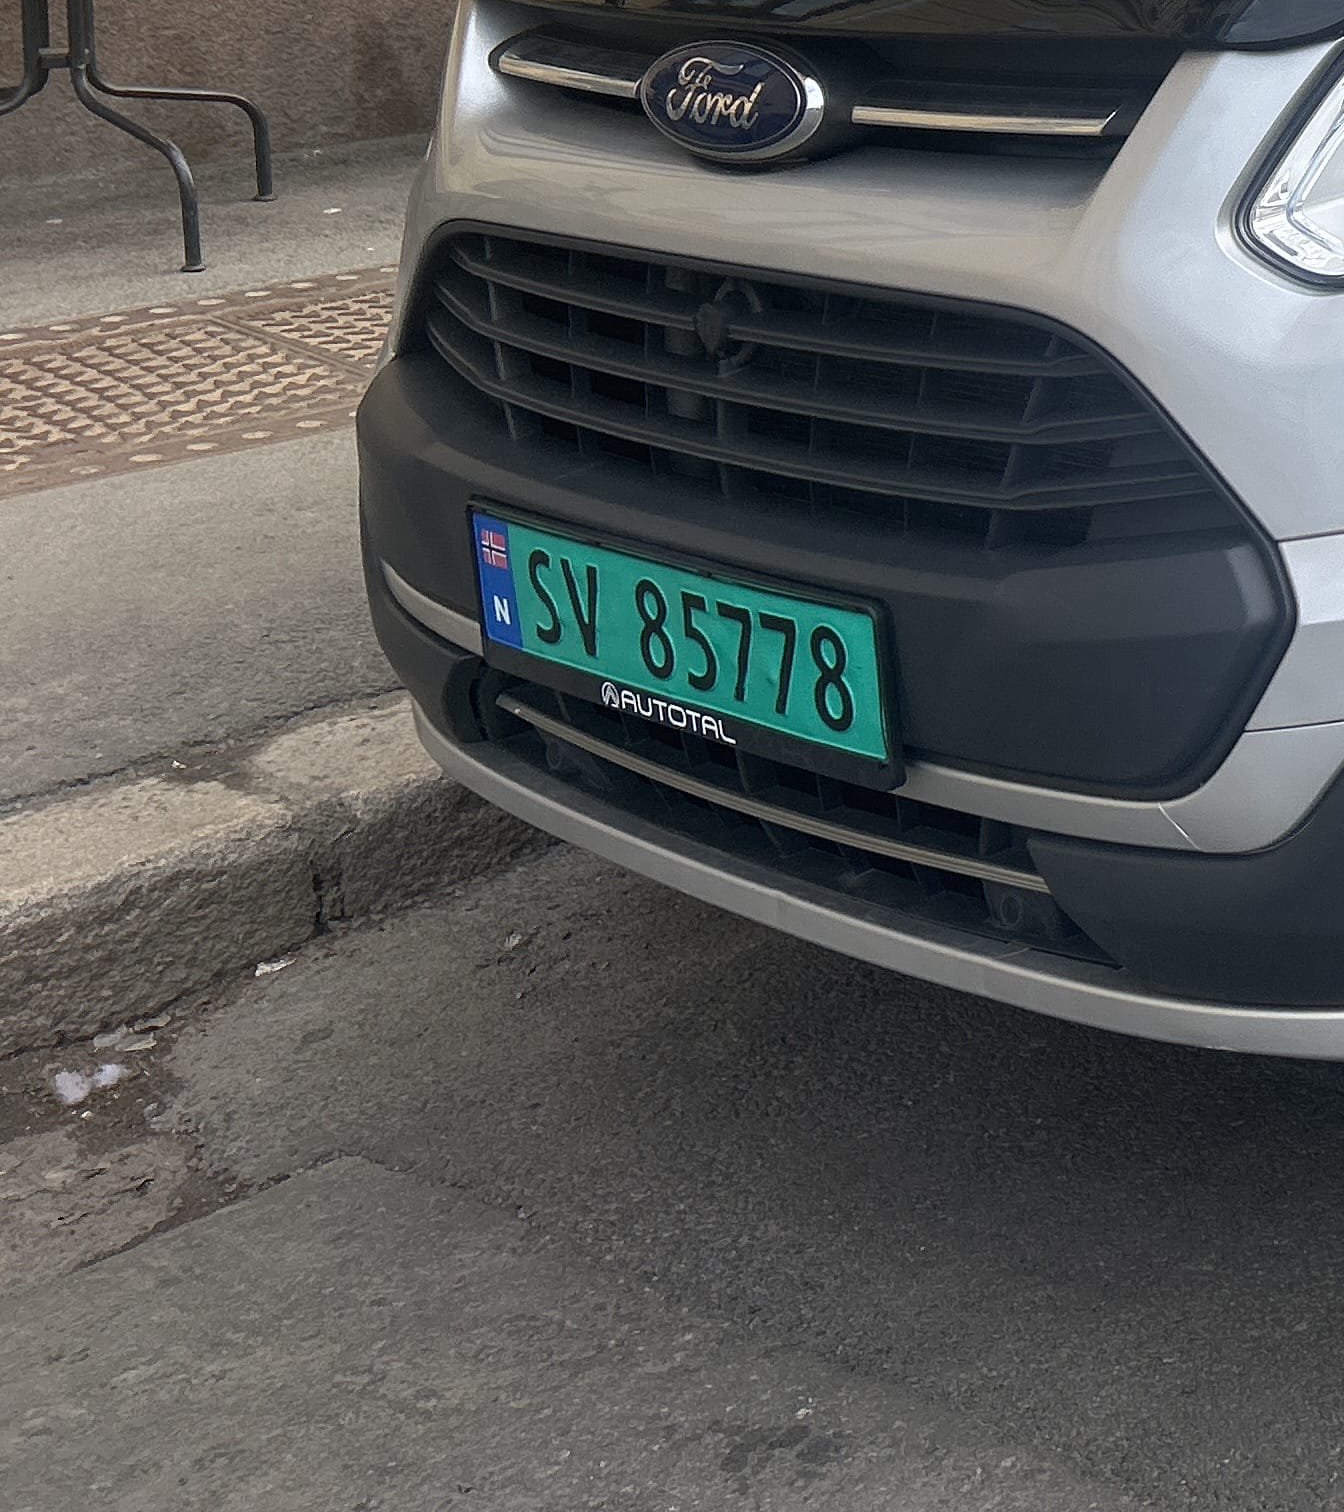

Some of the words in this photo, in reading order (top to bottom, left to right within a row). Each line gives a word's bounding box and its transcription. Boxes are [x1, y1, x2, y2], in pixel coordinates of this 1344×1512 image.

[666, 57, 765, 129] Ford
[493, 594, 511, 625] N
[528, 549, 598, 657] SV
[635, 578, 854, 732] 85778
[621, 689, 736, 745] AUTOTAL
